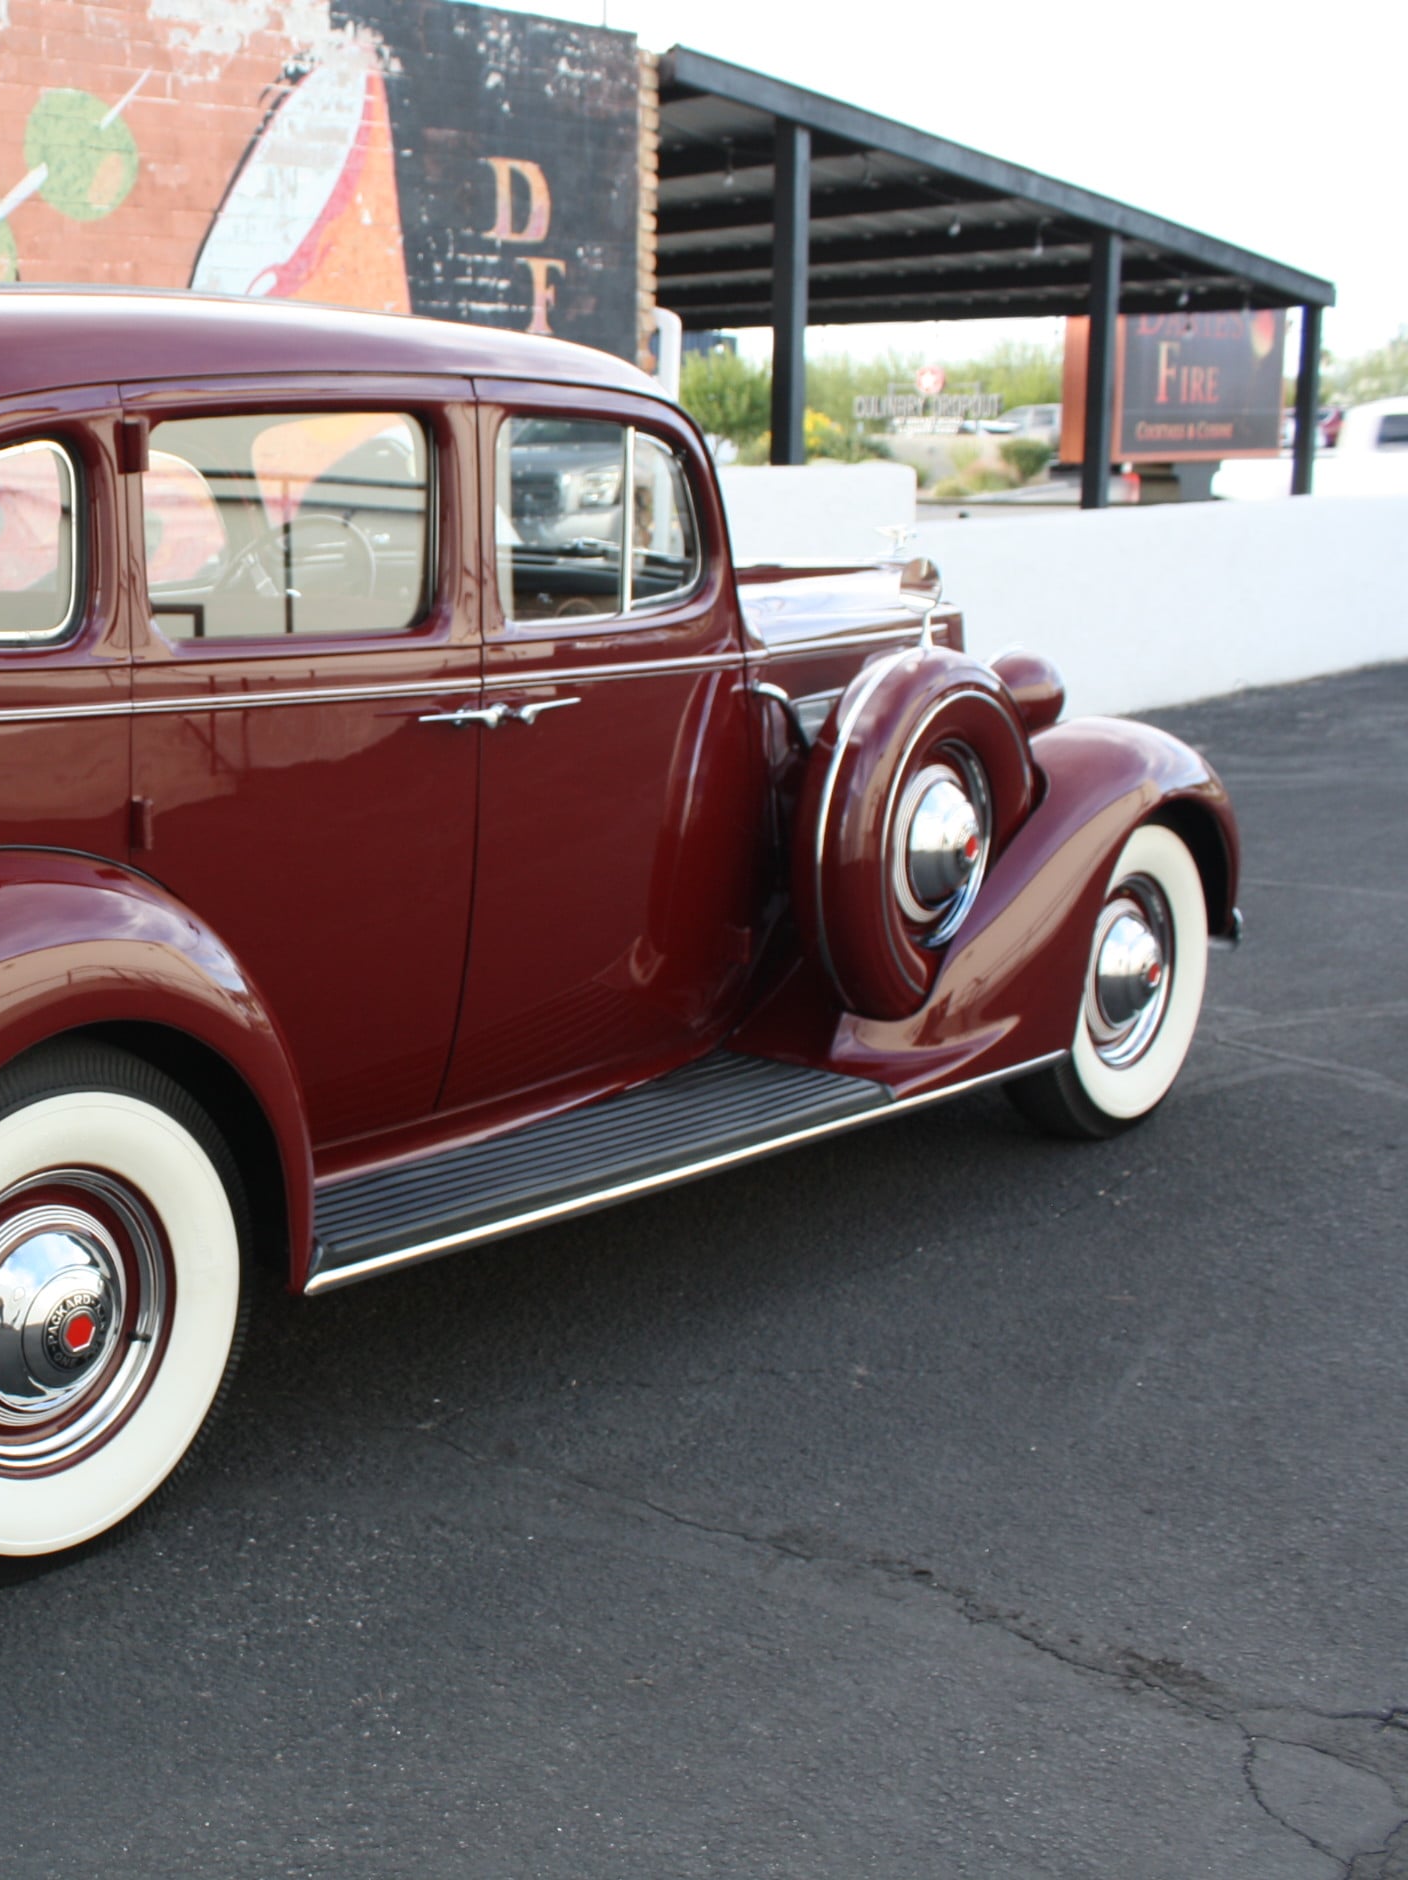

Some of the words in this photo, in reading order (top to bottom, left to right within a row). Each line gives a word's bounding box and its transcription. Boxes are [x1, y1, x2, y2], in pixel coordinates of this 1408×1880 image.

[482, 157, 551, 242] D
[523, 256, 566, 334] F
[1156, 341, 1220, 404] FIRE
[853, 394, 926, 418] CULINARY
[932, 393, 1003, 418] DROPOUT
[47, 1294, 92, 1345] PACKARD
